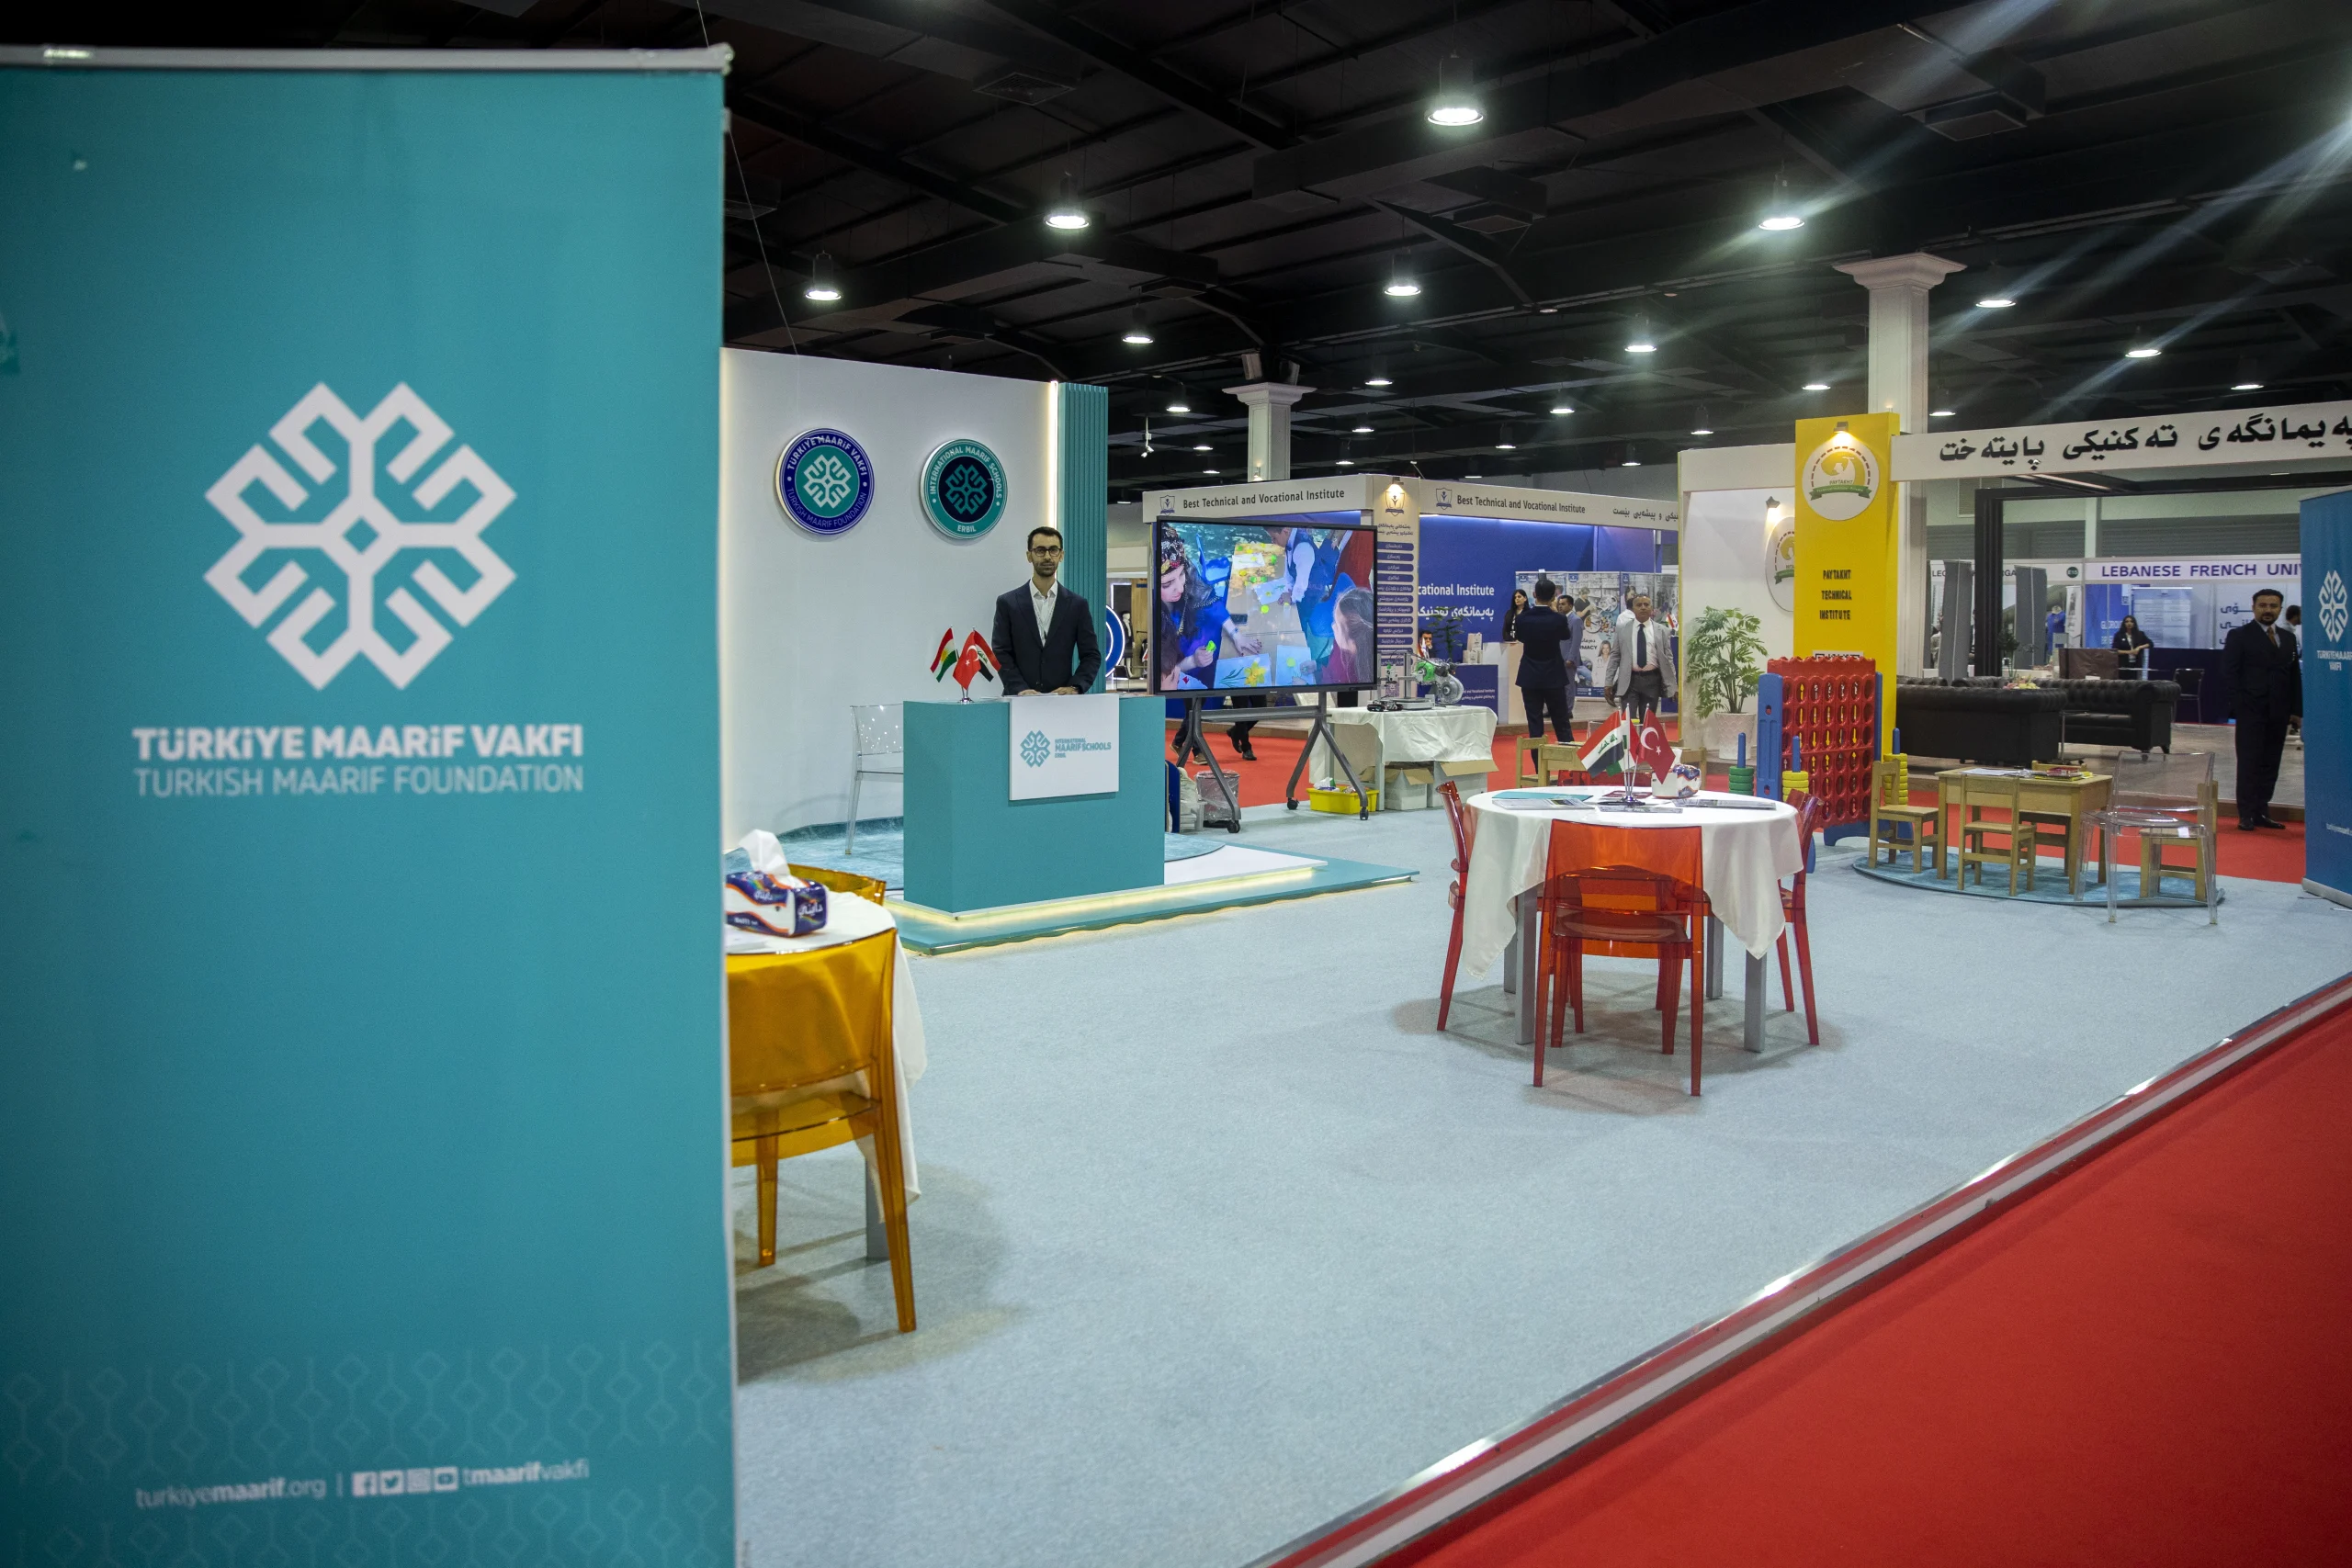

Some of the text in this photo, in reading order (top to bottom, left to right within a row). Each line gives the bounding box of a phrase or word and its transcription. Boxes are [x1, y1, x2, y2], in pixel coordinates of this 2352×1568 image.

[850, 448, 867, 476] VAKFI
[930, 446, 1002, 499] INTERNATIONAL MAARIF SCHOOLS
[786, 488, 867, 527] TURKISH MAARIF FOUNDATION
[1183, 488, 1345, 509] Best Technical and Vocational Institute
[1457, 494, 1586, 513] Best Technical and Vocational Institute
[957, 525, 977, 533] ERBIL
[1823, 570, 1851, 580] PAYTAKHT
[2101, 566, 2181, 578] LEBANESE
[2190, 564, 2257, 577] FRENCH
[1418, 582, 1454, 596] cational
[1457, 583, 1495, 596] Institute
[1821, 590, 1852, 600] TECHNICAL
[1819, 610, 1851, 620] INSTITUTE
[470, 724, 583, 757] VAKFI
[1055, 741, 1112, 751] MAARIF SCHOOLS
[133, 764, 583, 798] TURKISH MAARIF FOUNDATION
[135, 1476, 327, 1510] turkiyemaarif.org
